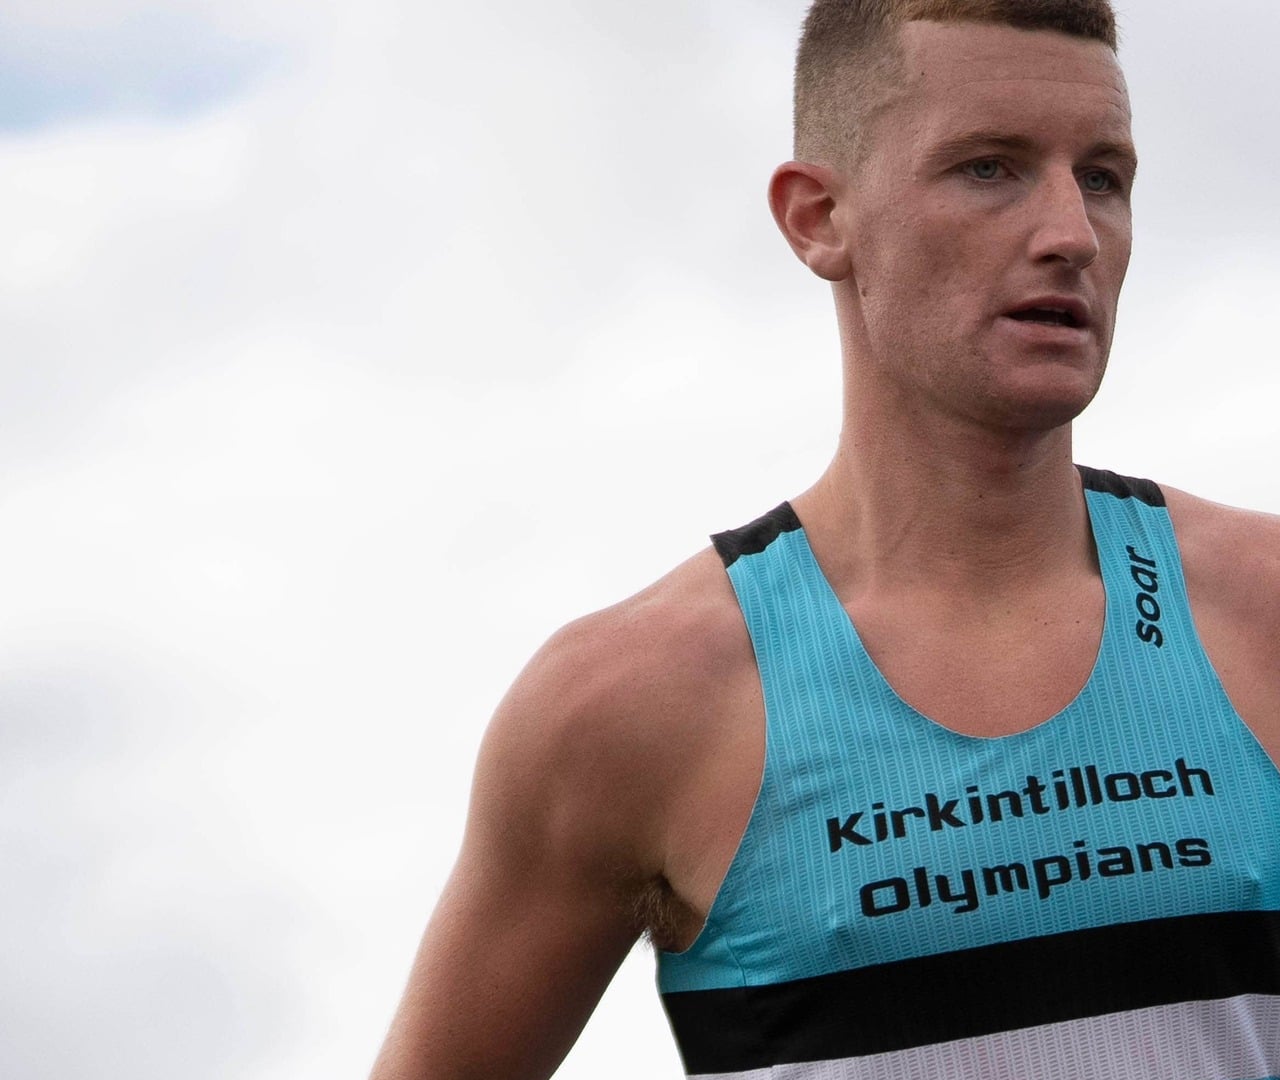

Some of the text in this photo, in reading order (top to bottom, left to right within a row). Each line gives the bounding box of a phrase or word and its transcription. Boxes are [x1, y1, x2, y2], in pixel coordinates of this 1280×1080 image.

[1126, 545, 1163, 648] soar
[826, 758, 1214, 853] Kirkintilloch
[859, 837, 1212, 917] Olympians
